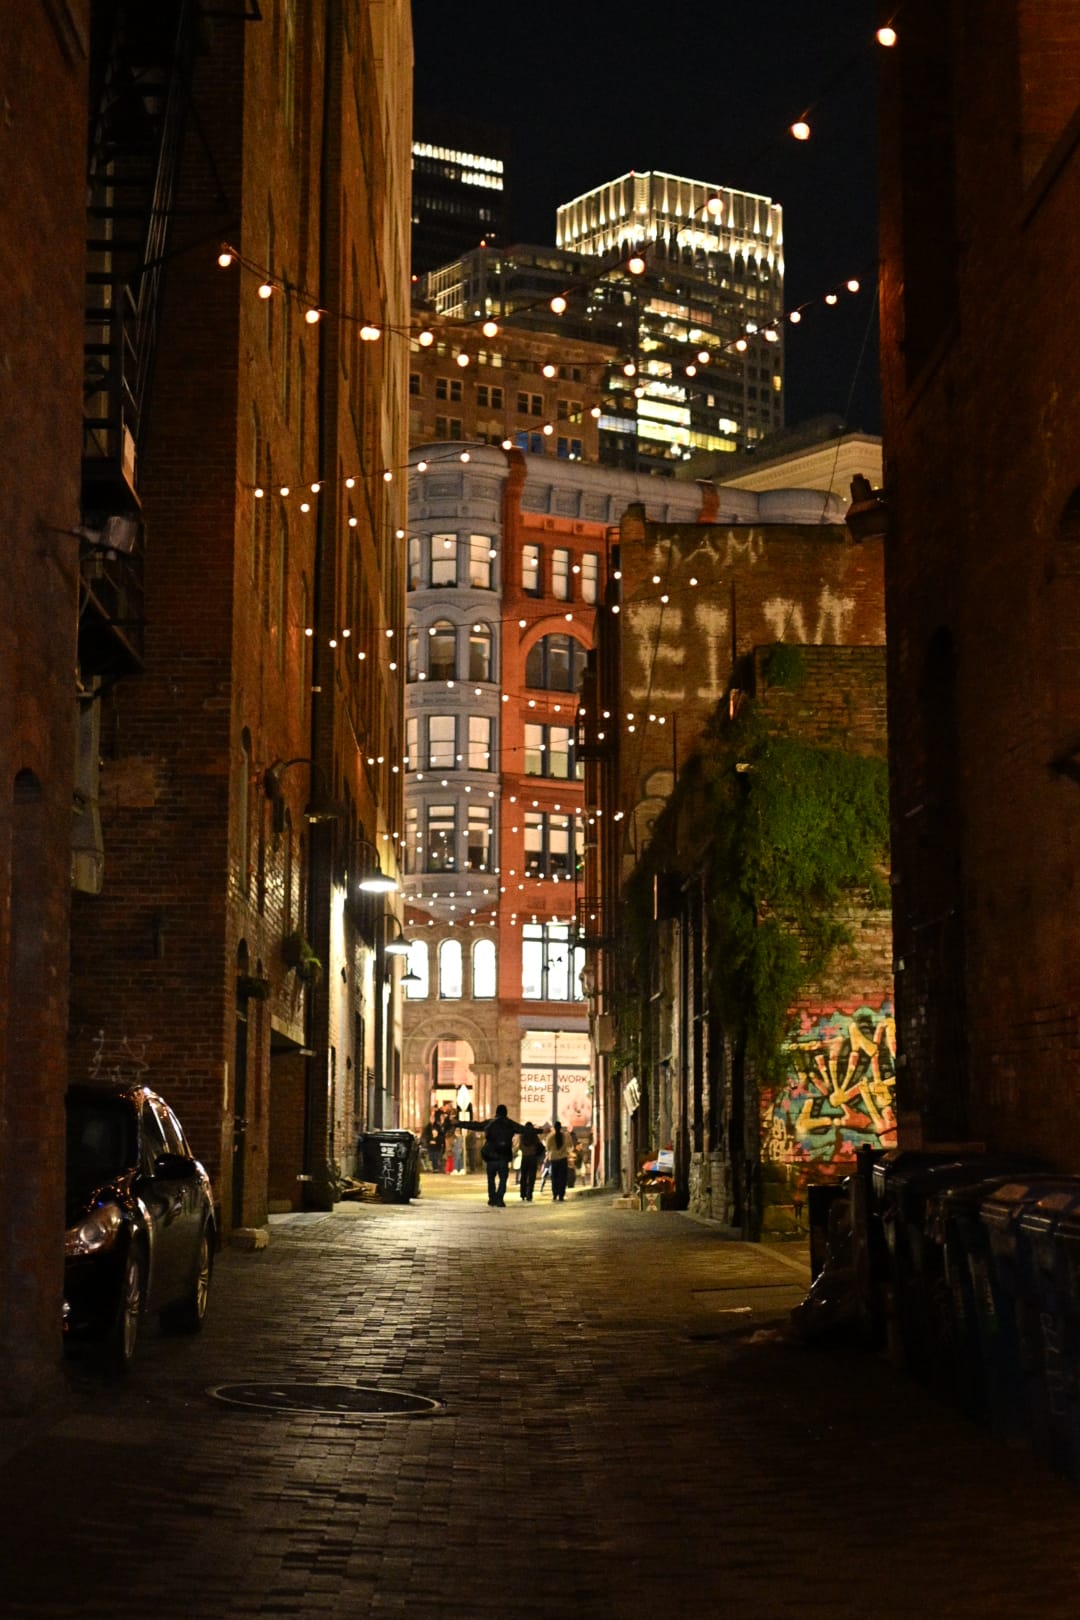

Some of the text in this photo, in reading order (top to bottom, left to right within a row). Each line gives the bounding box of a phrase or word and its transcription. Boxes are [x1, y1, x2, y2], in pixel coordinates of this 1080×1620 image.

[520, 1073, 588, 1083] GREAT WORK
[520, 1094, 545, 1103] HERE
